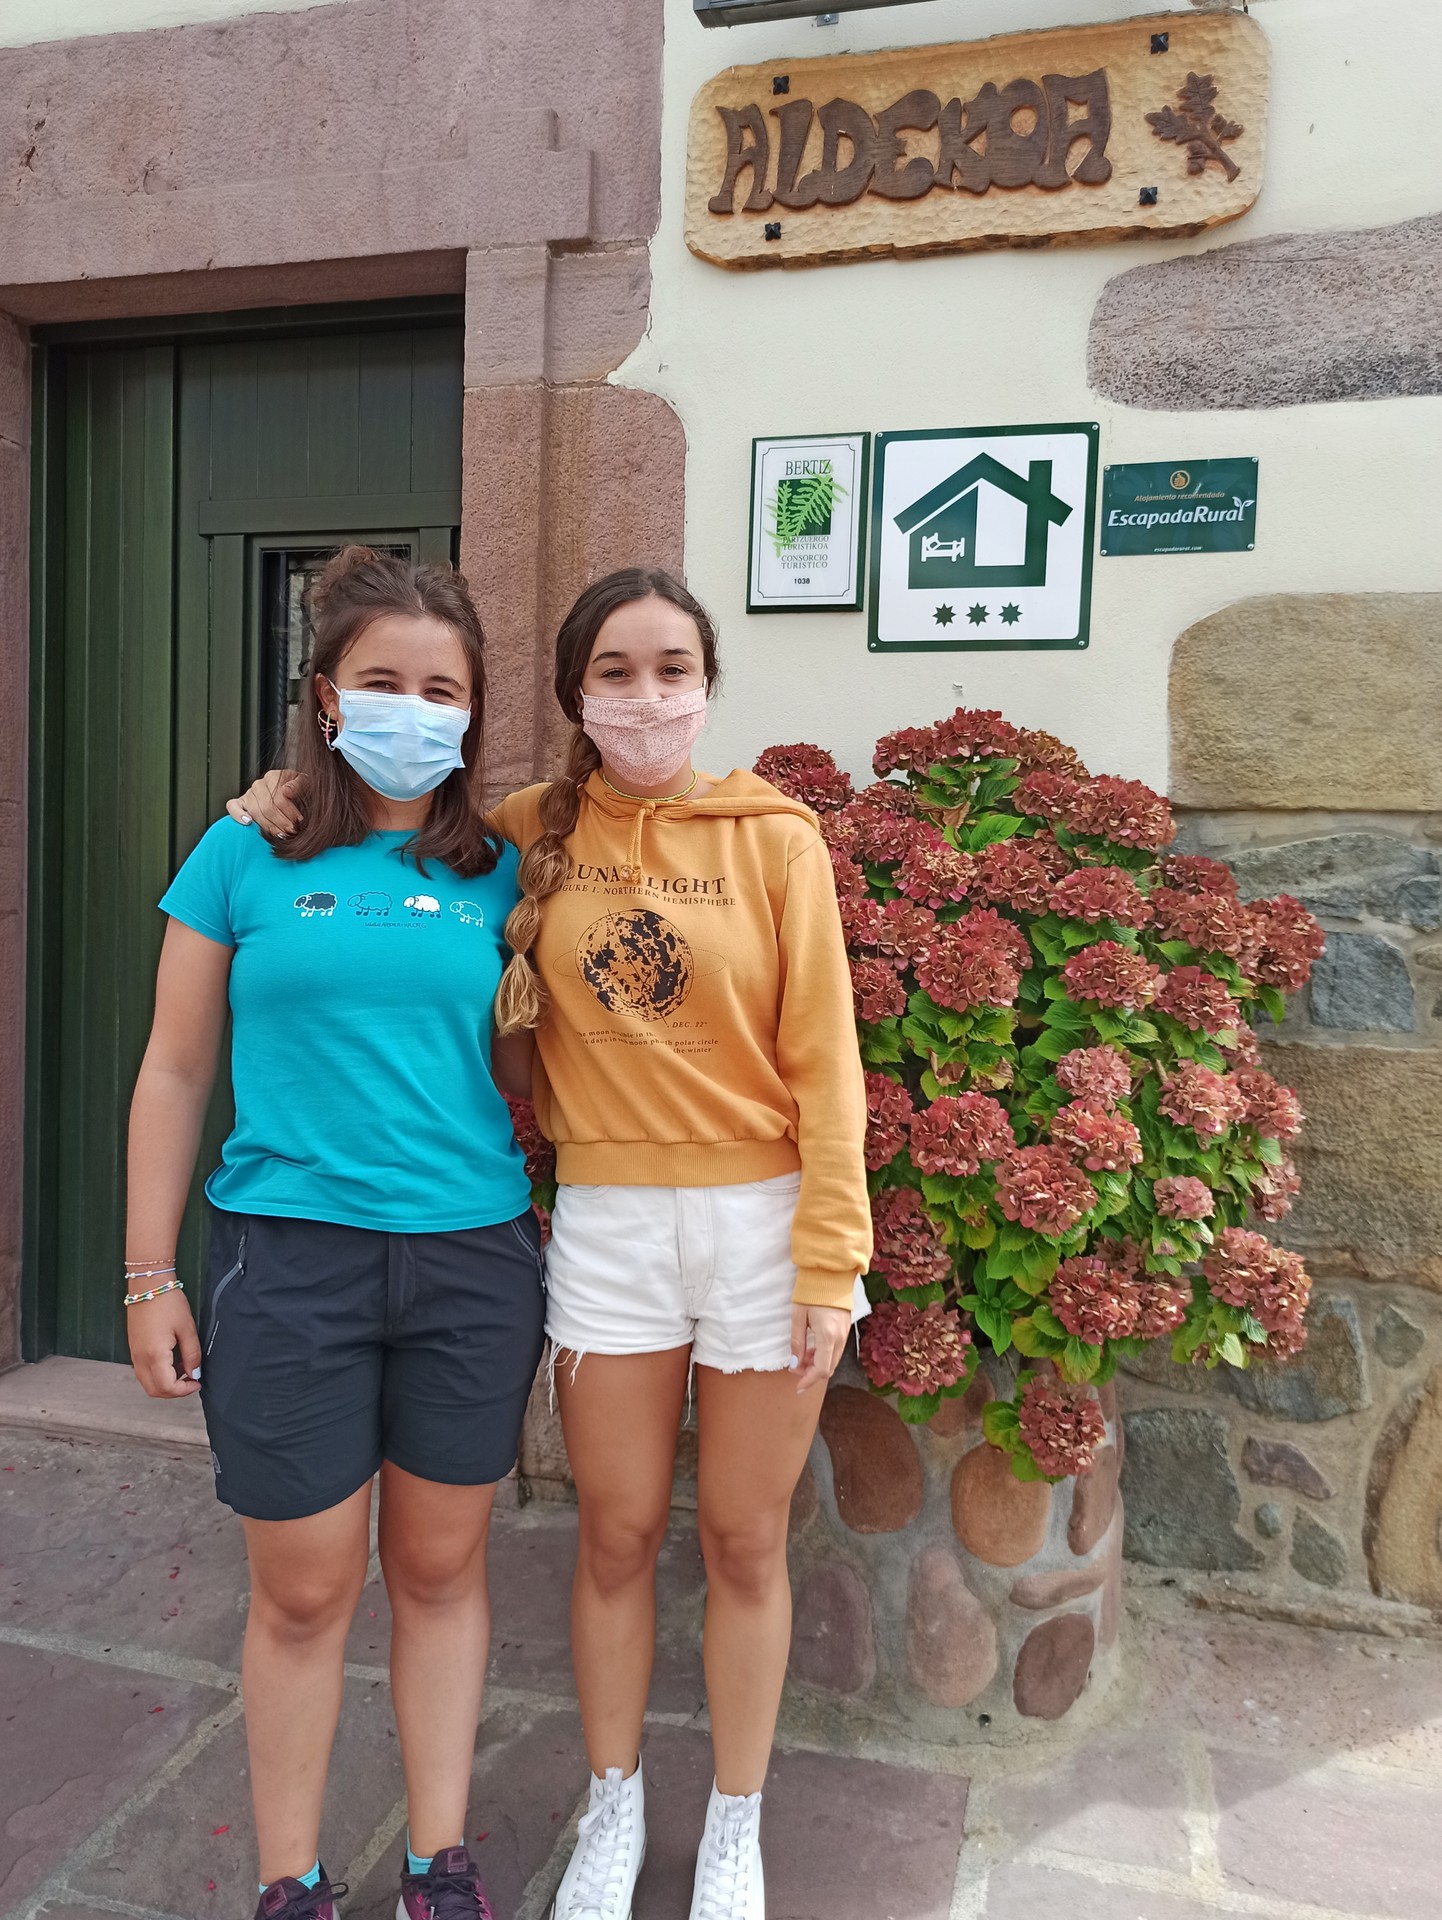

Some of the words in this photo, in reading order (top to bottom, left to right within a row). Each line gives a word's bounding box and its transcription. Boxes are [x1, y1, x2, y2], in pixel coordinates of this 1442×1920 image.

[708, 67, 1112, 214] ALDEKOA
[785, 459, 832, 476] BERTIZ
[1134, 494, 1176, 503] Alojamiento
[1178, 491, 1226, 500] recomendado
[1108, 500, 1250, 529] EscapadaRural
[782, 543, 829, 551] TURISTIKOA
[781, 554, 828, 562] CONSORCIO
[781, 561, 828, 569] TURISTICO
[794, 577, 811, 585] 1038
[566, 863, 640, 883] LUNA
[646, 876, 726, 895] LIGHT
[557, 883, 589, 893] IGURE
[603, 886, 660, 899] NORTHERN
[663, 896, 737, 907] HEMISPHERE
[674, 1039, 695, 1047] polar
